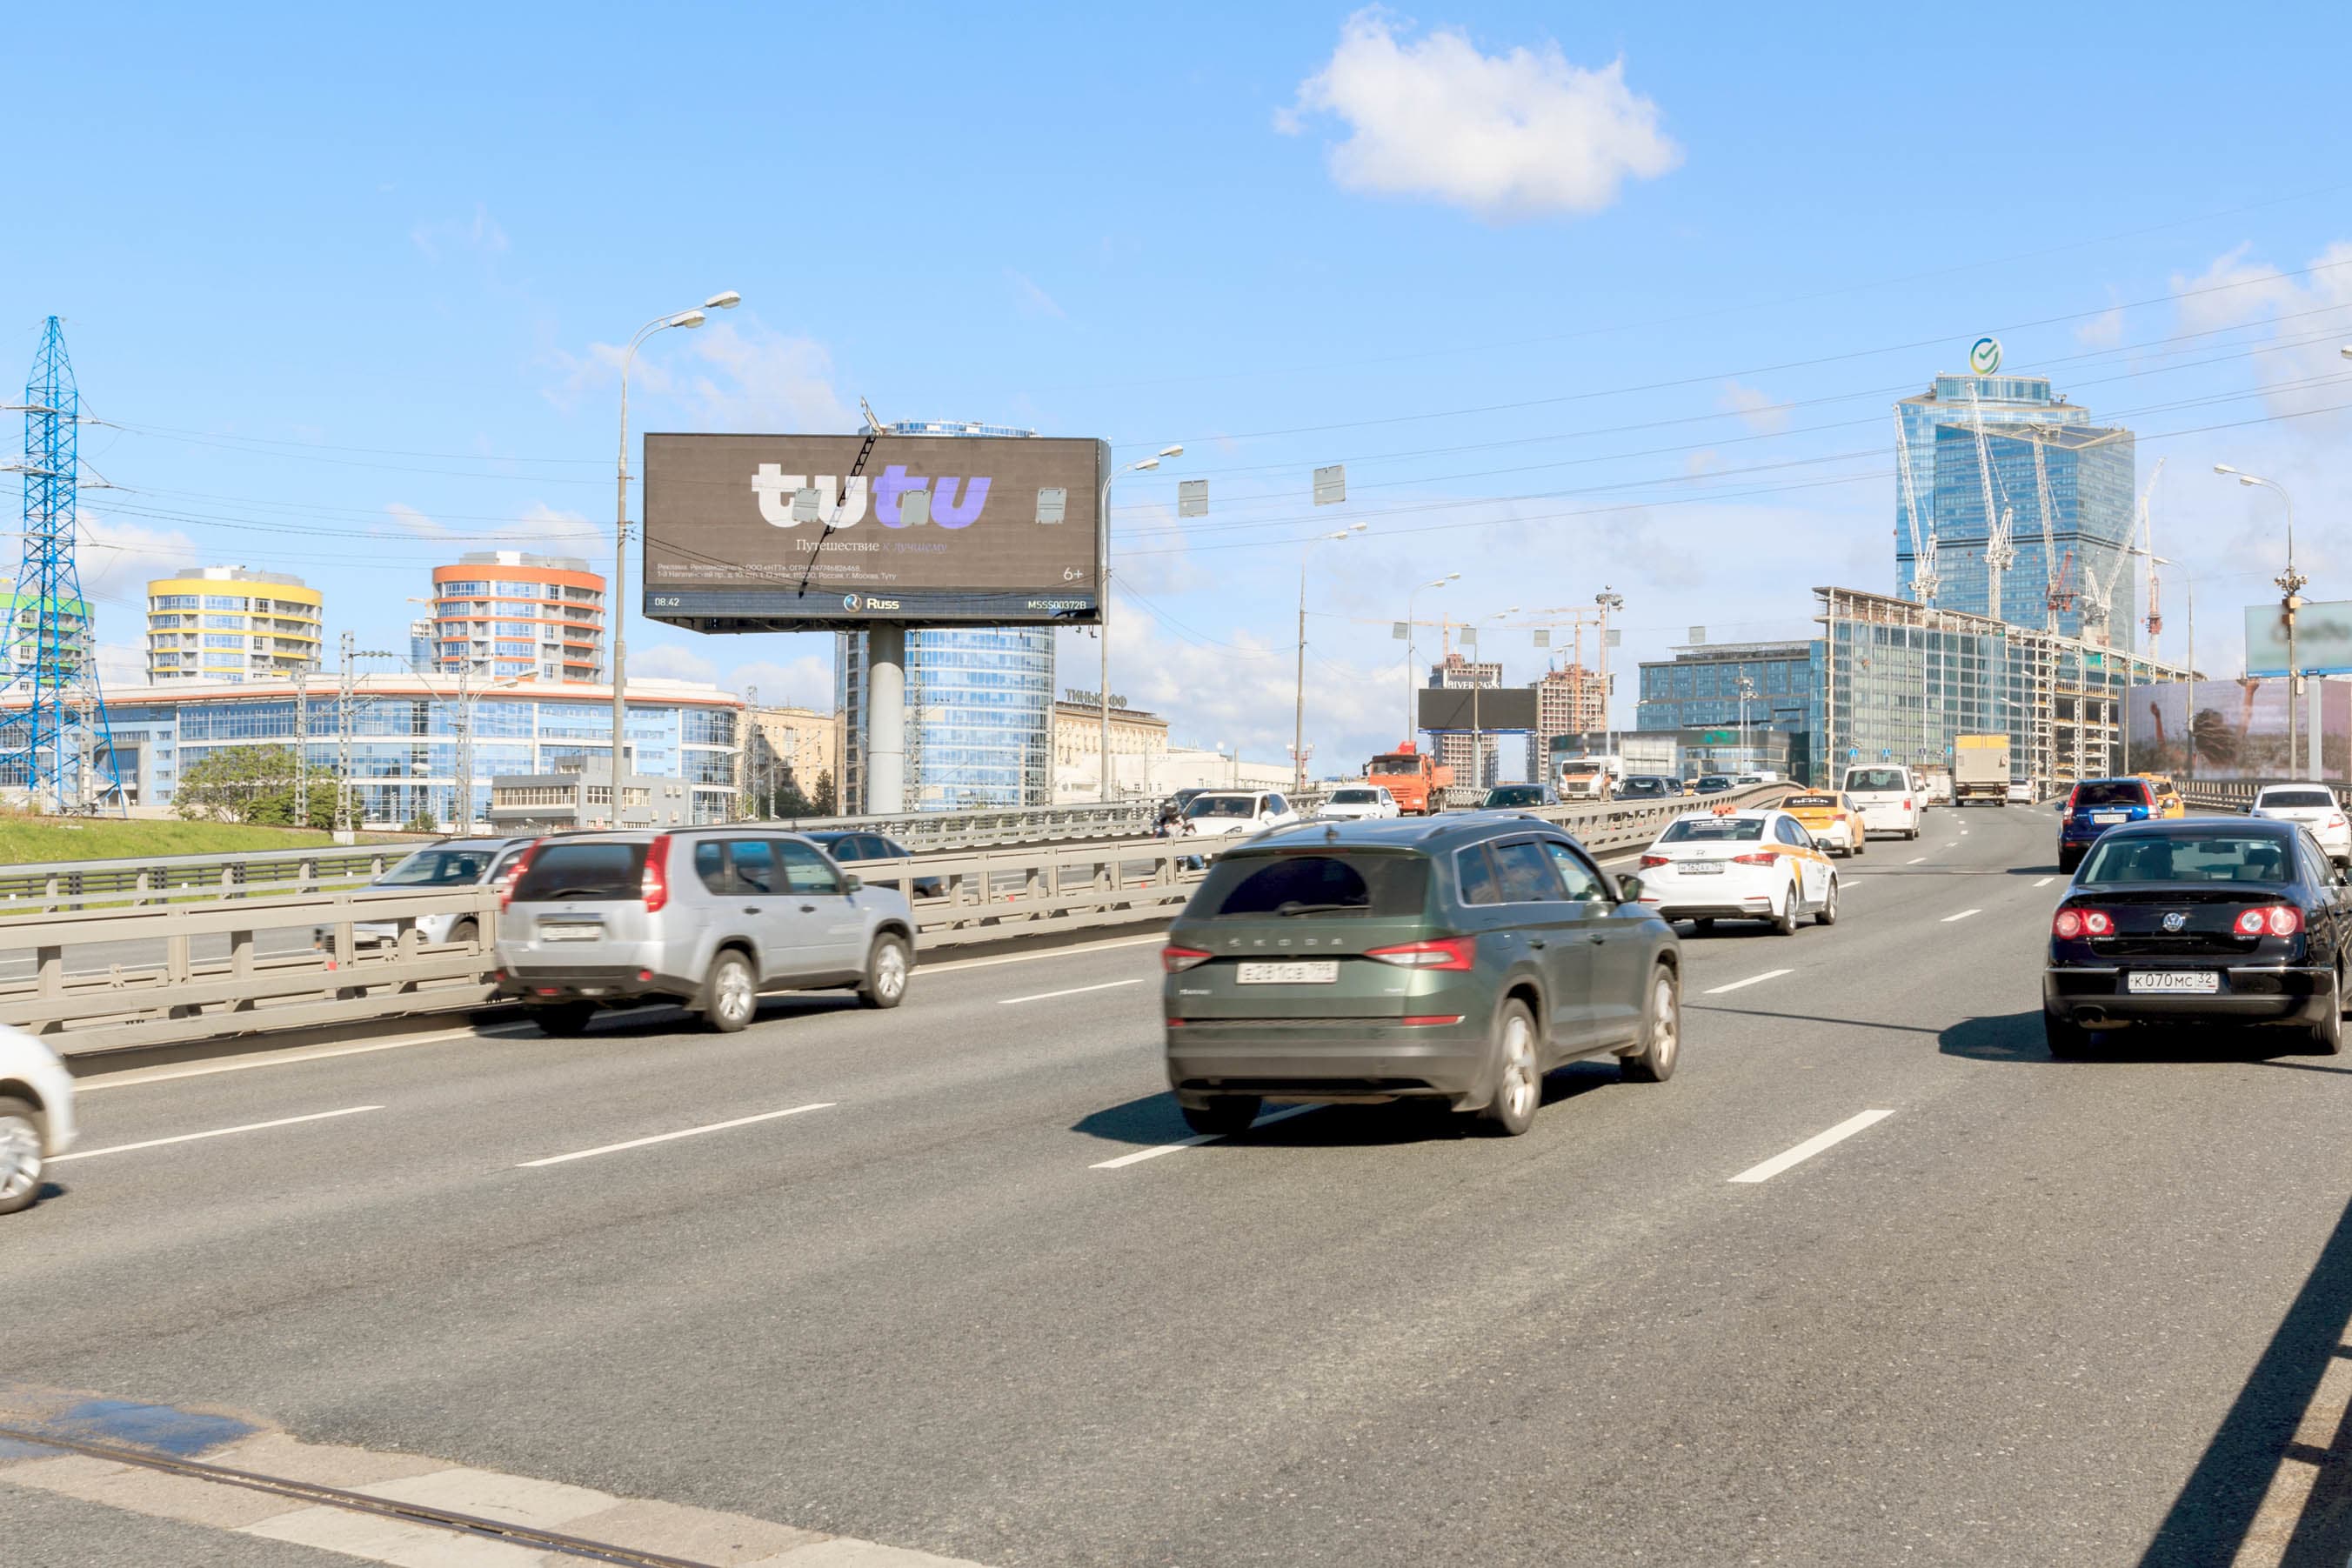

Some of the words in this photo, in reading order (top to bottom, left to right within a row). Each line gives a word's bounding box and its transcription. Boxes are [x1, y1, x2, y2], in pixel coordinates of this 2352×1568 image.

[752, 464, 992, 529] tutu
[796, 539, 880, 552] Путешествие
[1063, 567, 1084, 580] 6+
[654, 597, 680, 607] 08:42
[866, 597, 900, 610] Russ
[1447, 681, 1474, 690] RIVER
[1065, 688, 1128, 709] ТИНЬКФФ
[2135, 973, 2193, 987] К070МС
[2197, 972, 2213, 984] 32
